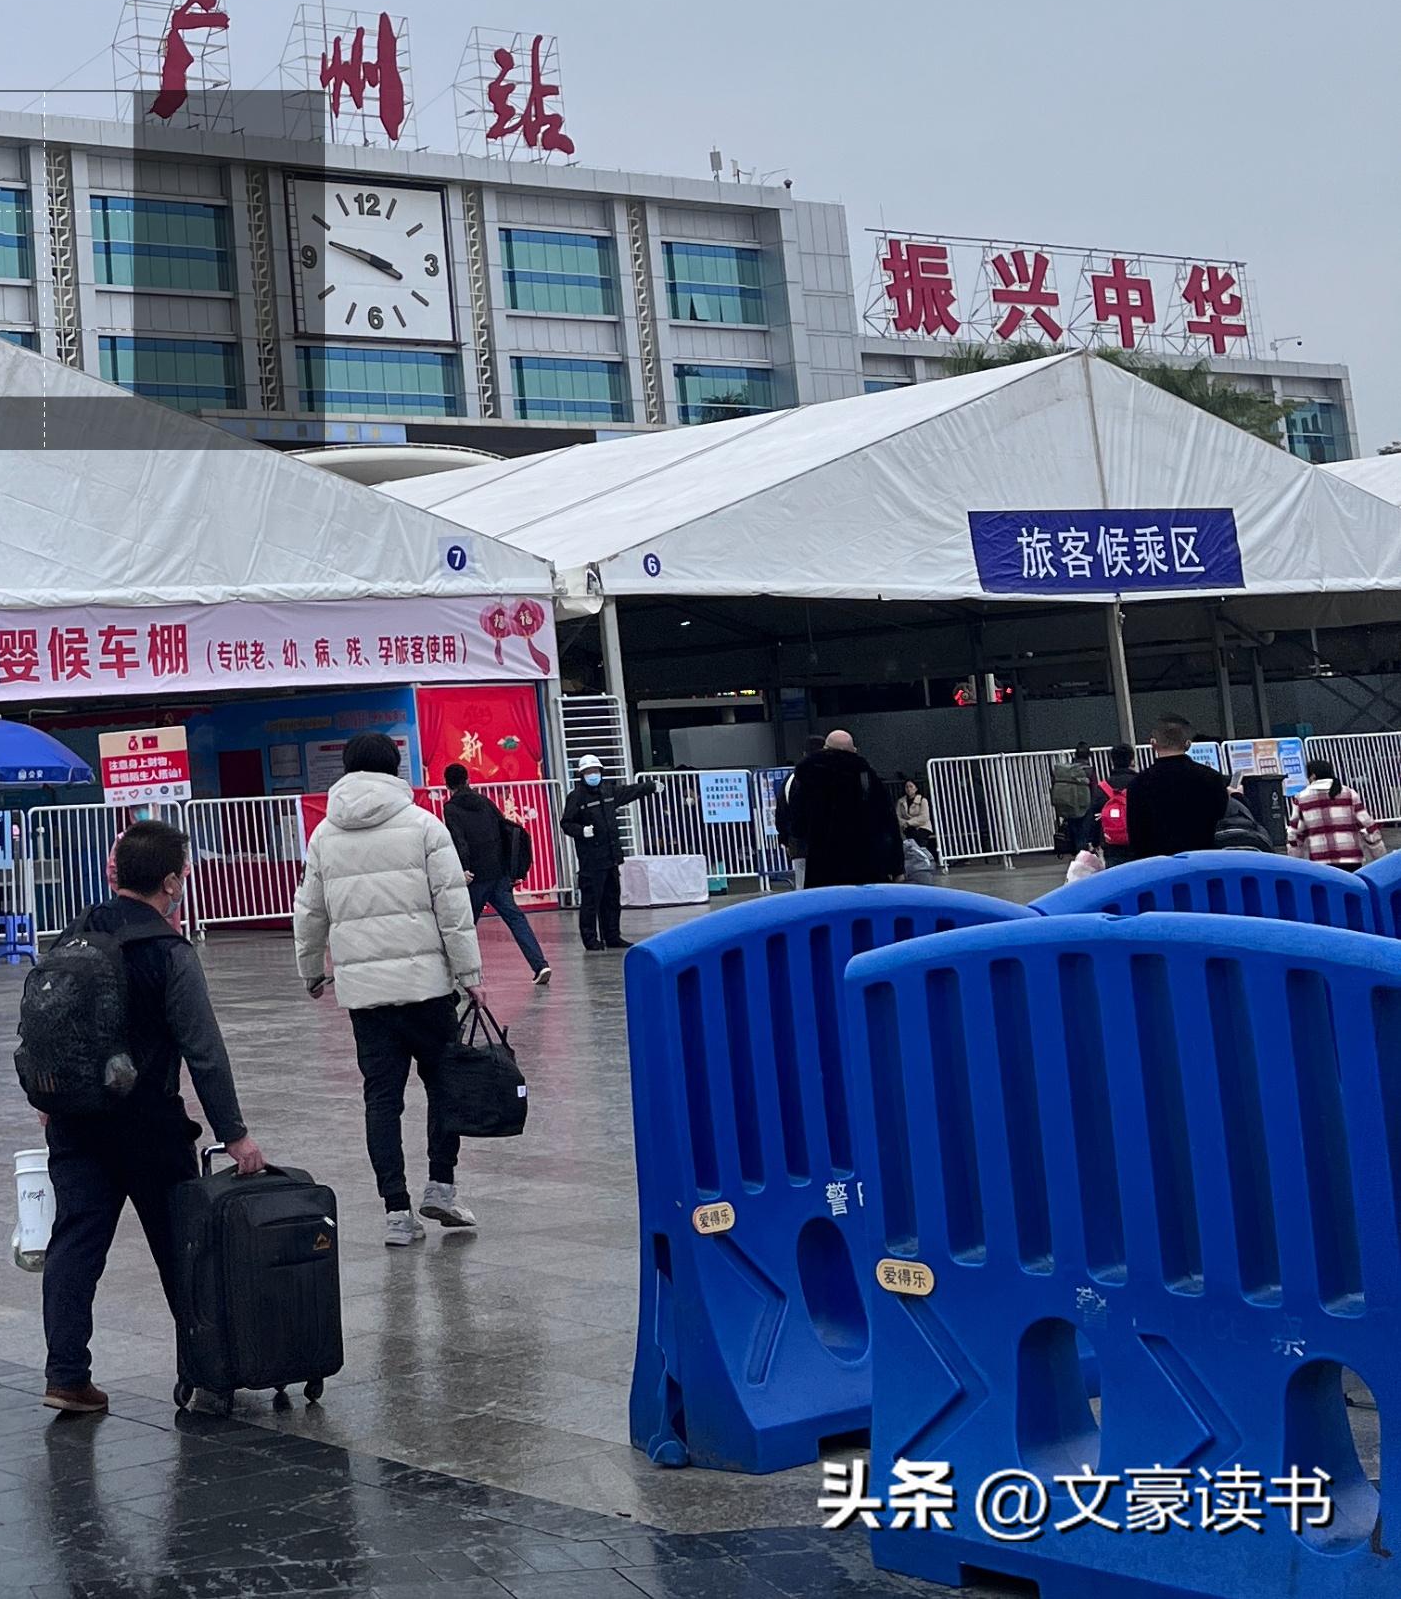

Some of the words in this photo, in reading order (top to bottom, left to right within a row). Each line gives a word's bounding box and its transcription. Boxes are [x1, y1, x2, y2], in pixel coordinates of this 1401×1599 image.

[353, 193, 381, 216] 12
[301, 245, 318, 269] 9
[424, 253, 439, 277] 3
[882, 239, 1248, 354] 振兴中华
[367, 306, 384, 330] 6
[451, 550, 462, 568] 7
[1017, 526, 1205, 578] 旅客候乘区
[647, 557, 658, 574] 6
[459, 730, 483, 765] 新
[699, 1208, 730, 1229] 爱得乐
[883, 1266, 927, 1289] 爱得乐
